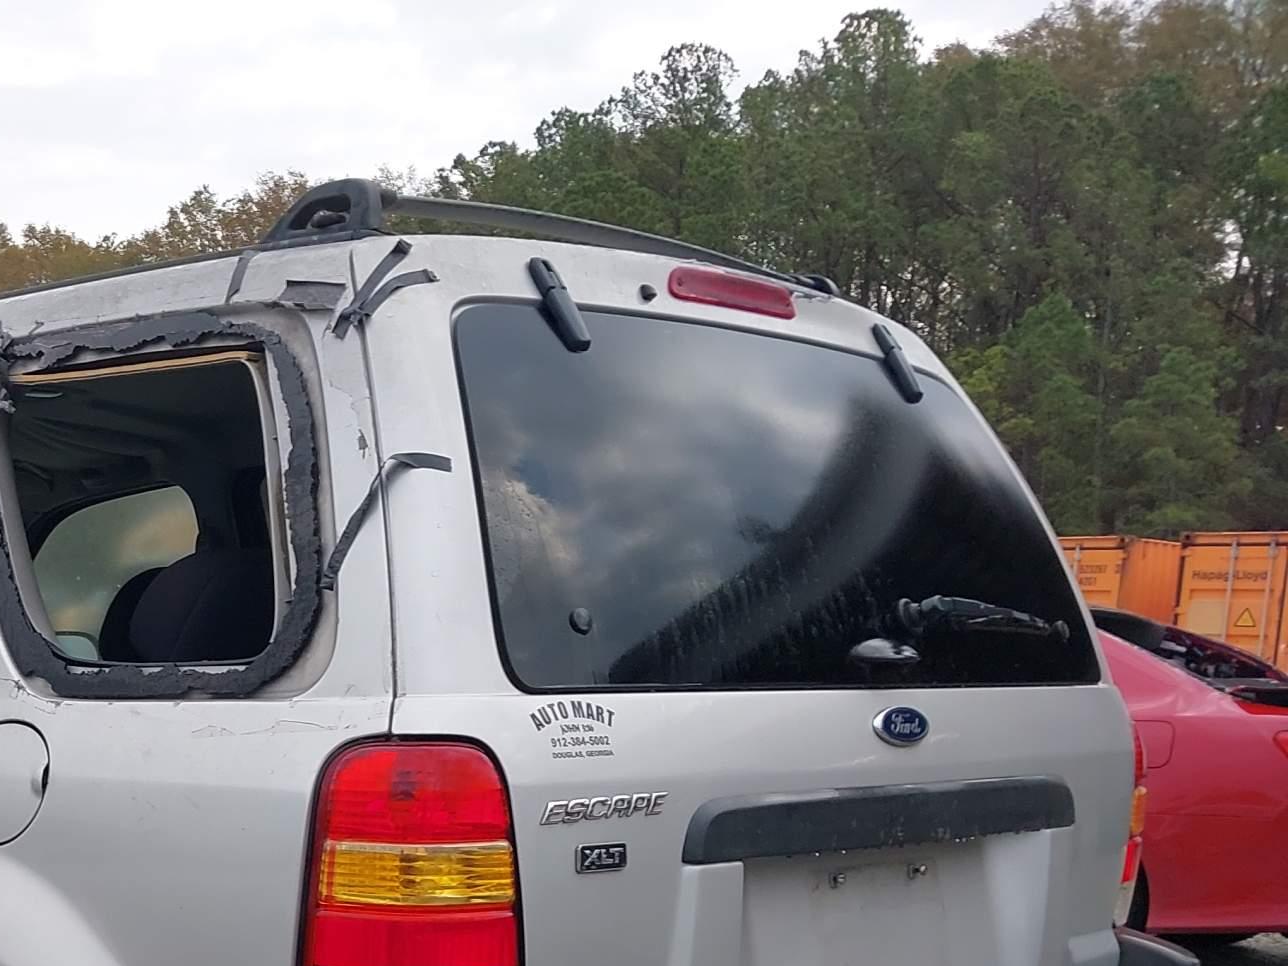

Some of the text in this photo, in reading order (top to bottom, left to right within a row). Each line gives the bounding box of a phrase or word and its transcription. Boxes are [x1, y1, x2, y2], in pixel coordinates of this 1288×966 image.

[529, 700, 615, 731] AUTO MART
[551, 736, 611, 747] 912-384-5002
[539, 791, 669, 826] ESCAPE
[583, 847, 624, 867] XLT
